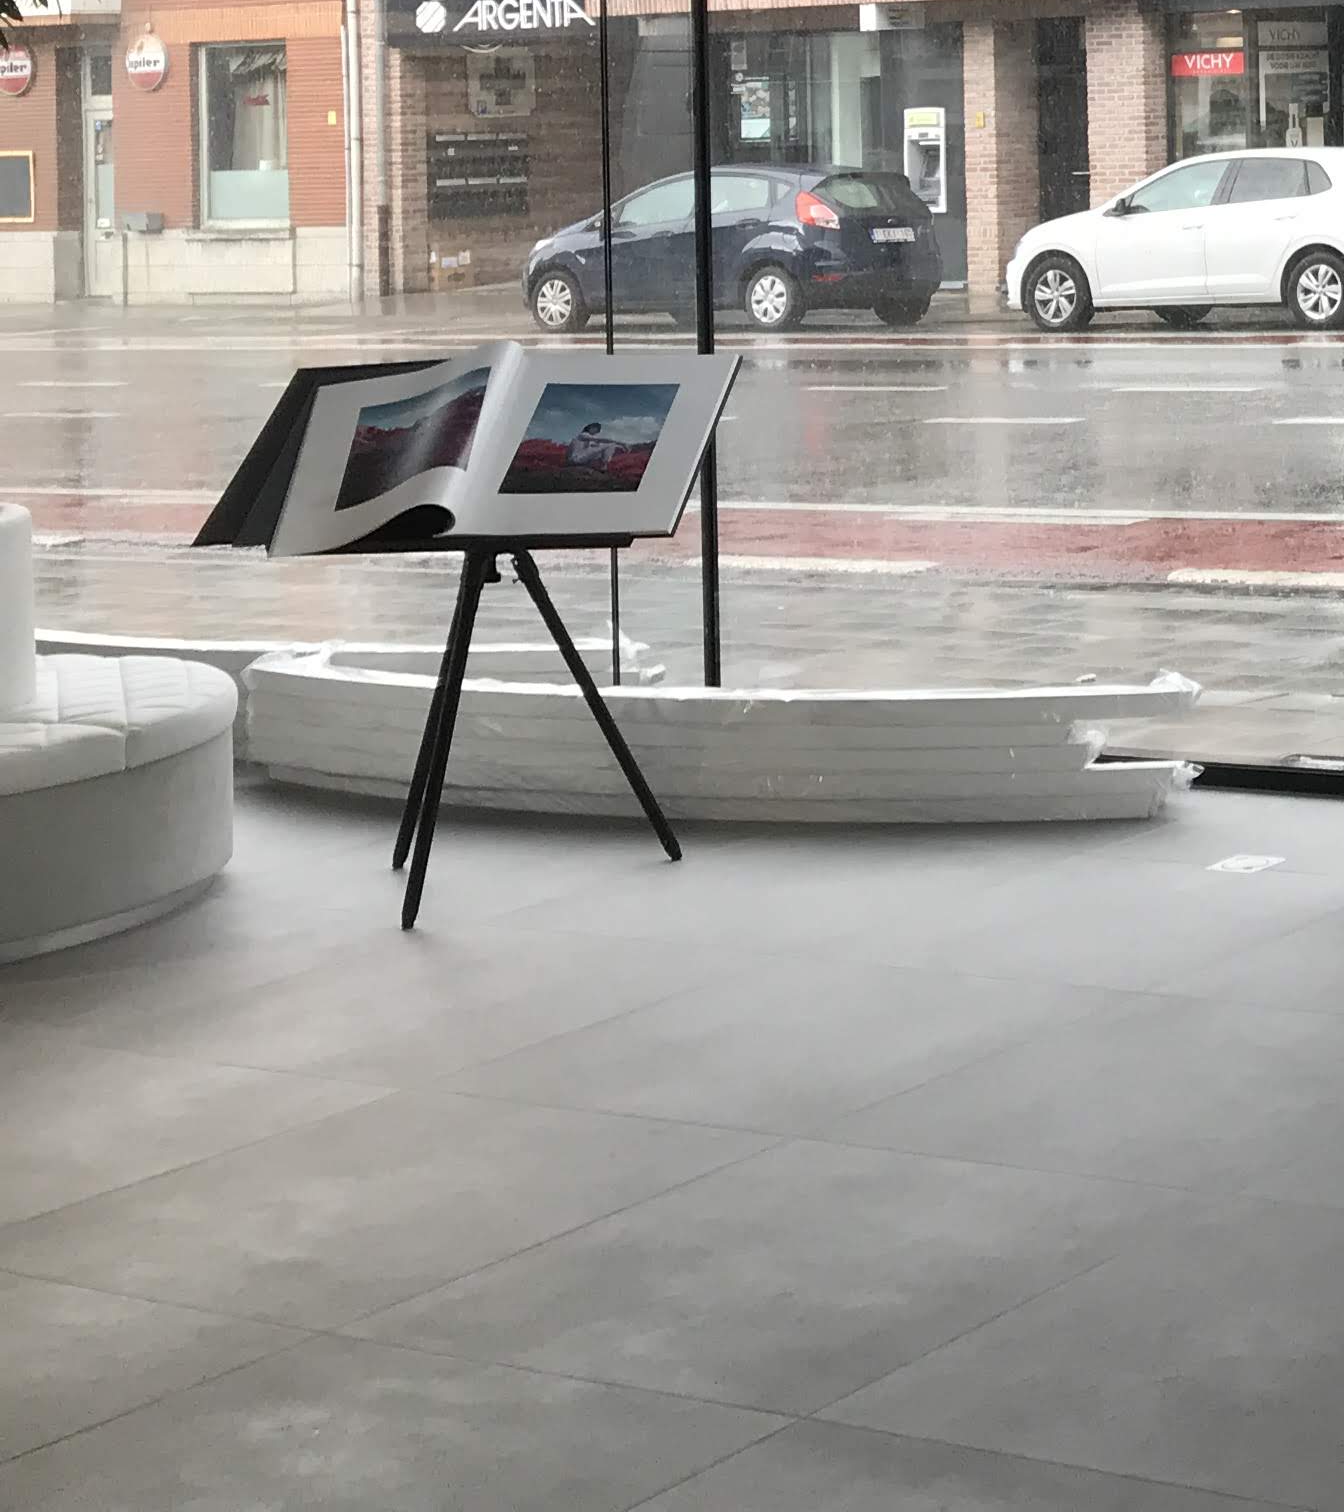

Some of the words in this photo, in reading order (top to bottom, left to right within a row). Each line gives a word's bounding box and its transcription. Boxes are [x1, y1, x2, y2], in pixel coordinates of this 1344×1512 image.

[128, 56, 160, 70] upiler
[1184, 52, 1234, 69] VICHY
[0, 61, 27, 76] piler
